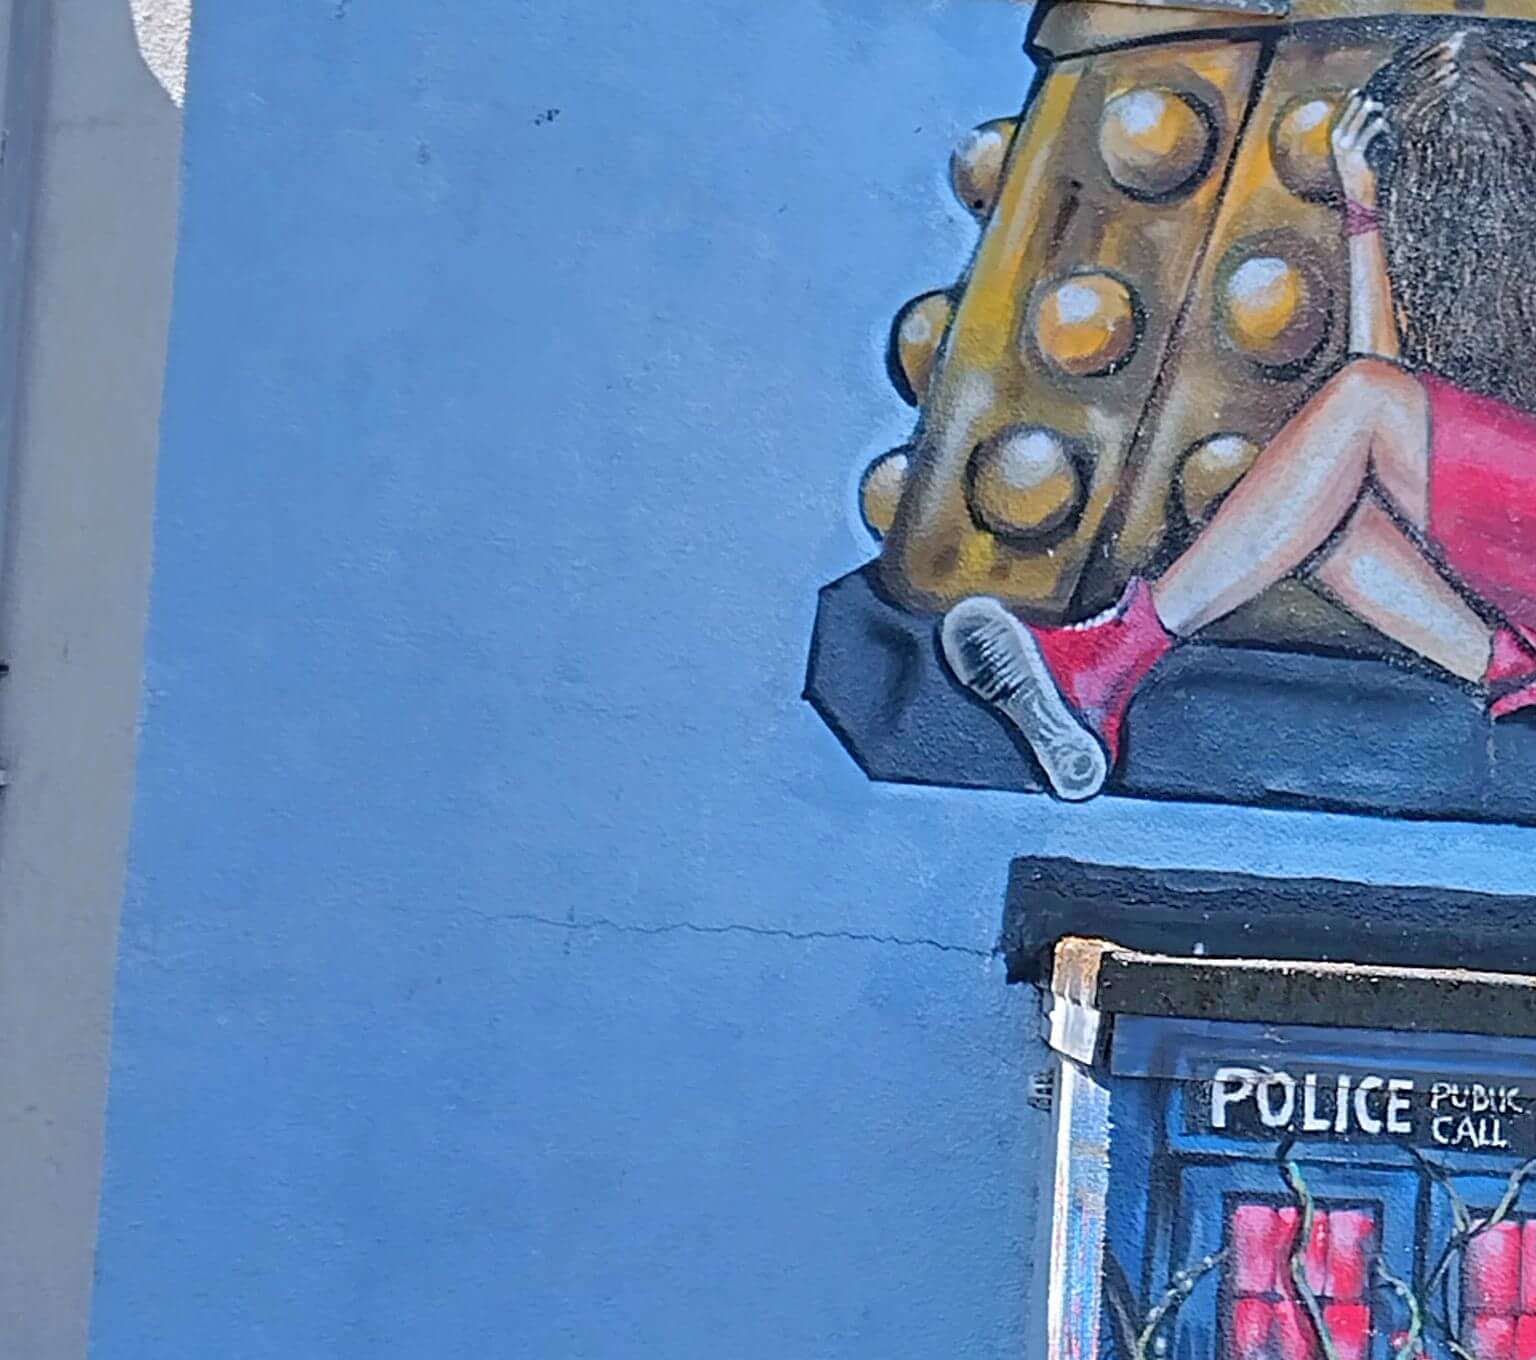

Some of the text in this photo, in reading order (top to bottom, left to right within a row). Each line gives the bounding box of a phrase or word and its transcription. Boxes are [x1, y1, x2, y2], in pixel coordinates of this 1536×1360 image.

[1211, 1066, 1413, 1134] POLICE
[1430, 1081, 1523, 1113] PUBLIC
[1431, 1115, 1508, 1148] CALL
